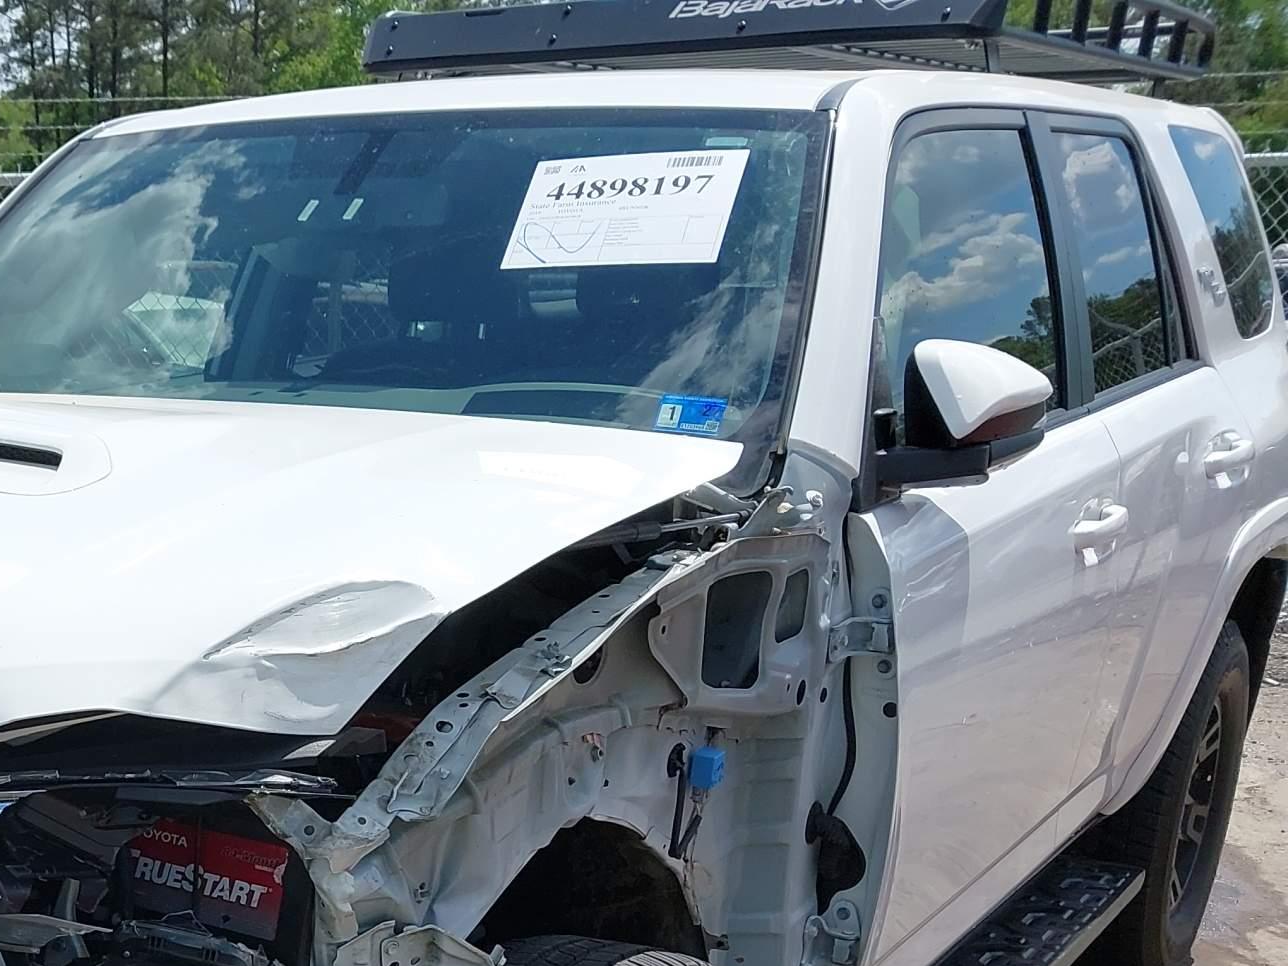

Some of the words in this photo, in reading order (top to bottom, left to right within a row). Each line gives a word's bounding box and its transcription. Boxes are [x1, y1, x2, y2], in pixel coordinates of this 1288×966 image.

[547, 174, 715, 200] 44898197
[669, 405, 677, 421] 1
[143, 828, 189, 849] OYOTA
